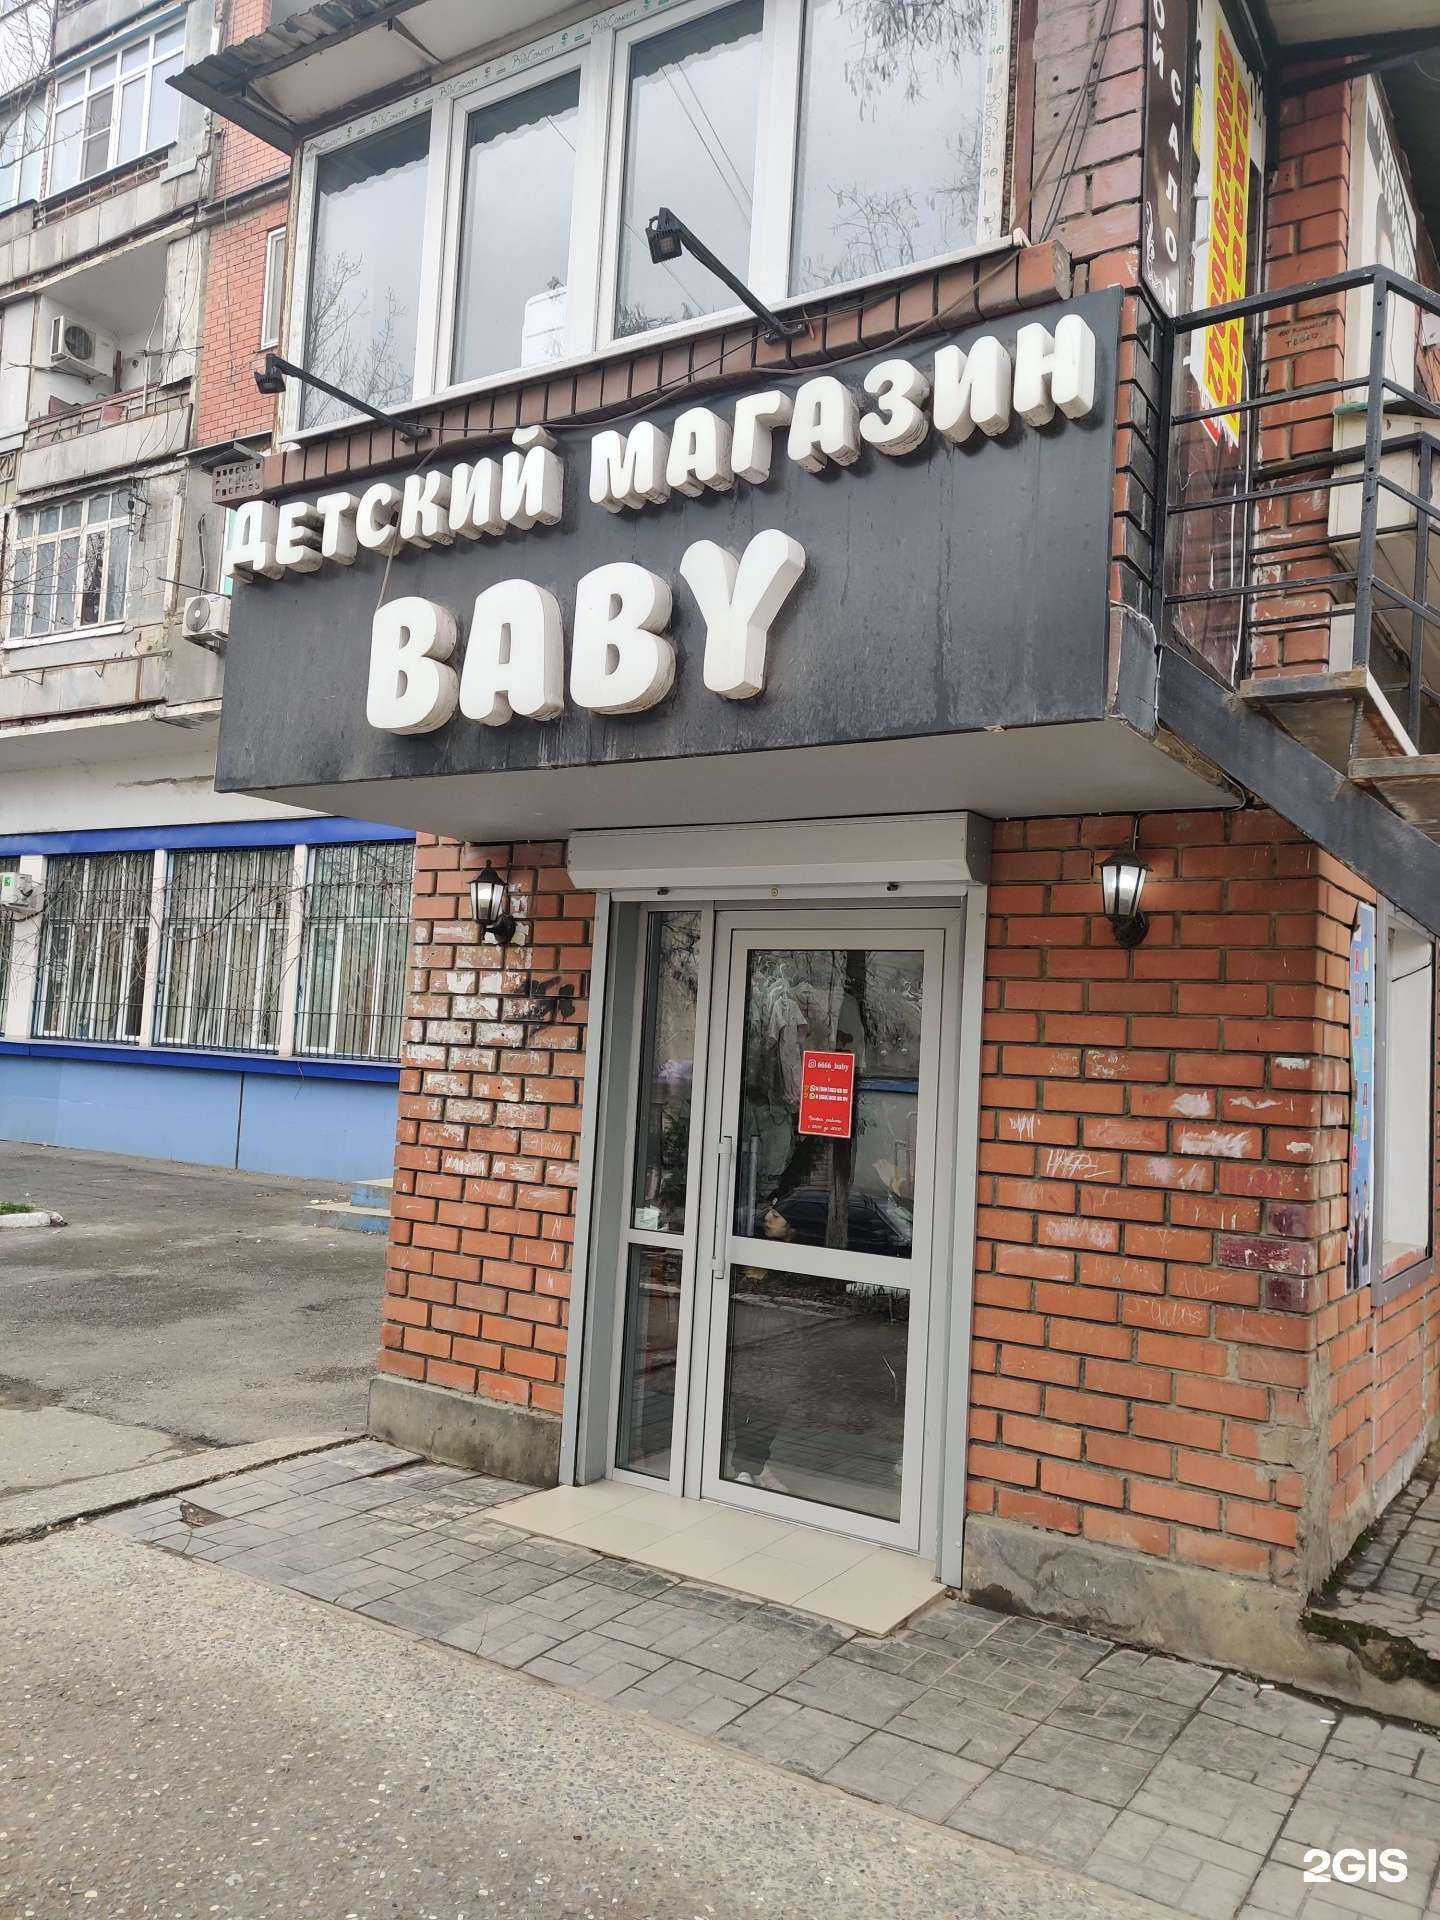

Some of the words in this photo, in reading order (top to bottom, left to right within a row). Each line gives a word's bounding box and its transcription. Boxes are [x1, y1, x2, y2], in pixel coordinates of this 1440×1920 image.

[1165, 68, 1182, 318] САЛОН
[224, 425, 564, 583] ДЕТСКИЙ
[589, 313, 1096, 514] МАГАЗИН
[366, 528, 806, 735] BABY
